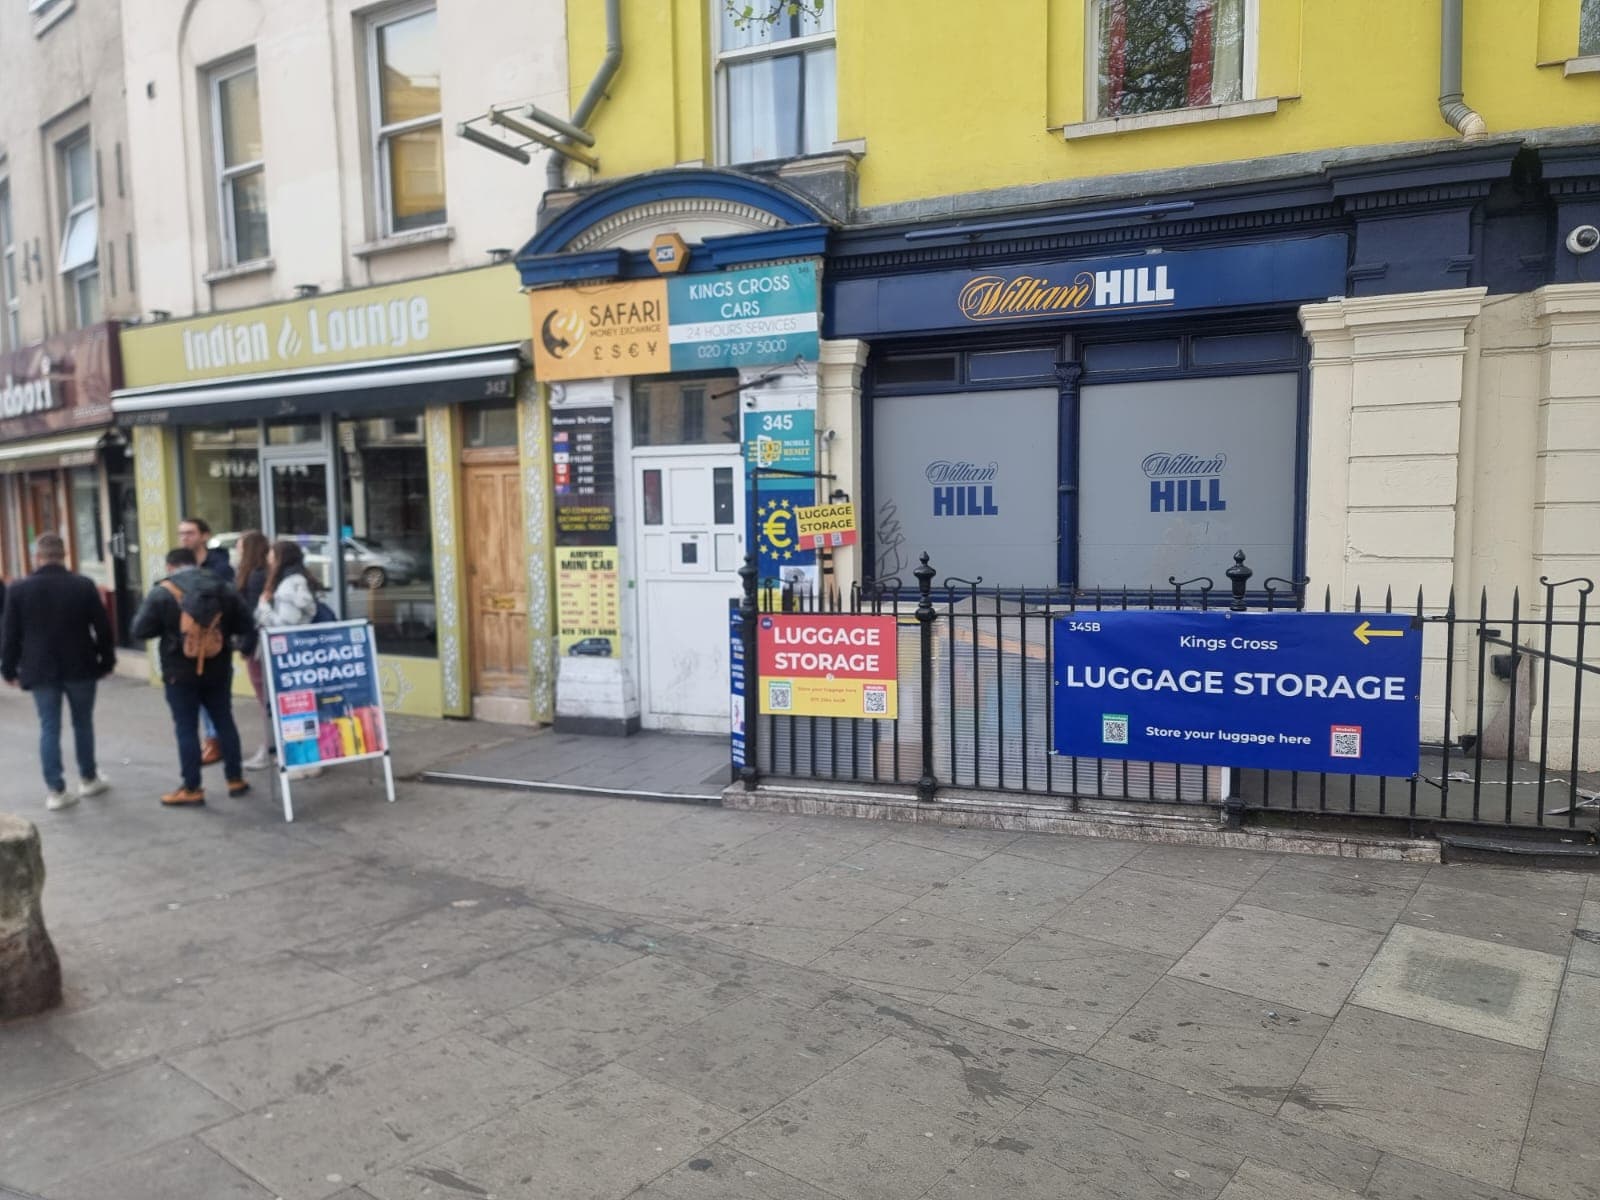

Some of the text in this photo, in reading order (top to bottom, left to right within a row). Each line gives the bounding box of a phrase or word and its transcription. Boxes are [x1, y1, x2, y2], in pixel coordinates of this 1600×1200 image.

[689, 275, 790, 300] KINGS CROSS
[959, 265, 1175, 319] William HILL
[590, 299, 661, 327] SAFARI
[721, 301, 760, 319] CARS
[183, 296, 429, 371] Indian Lounge
[688, 319, 797, 339] 24 HOURS SERVICES
[593, 341, 657, 360] £ $ € ¥
[697, 339, 787, 358] 020 7837 5000
[763, 414, 793, 431] 345
[925, 460, 998, 485] William
[1142, 452, 1227, 478] William
[933, 486, 998, 516] HILL
[1150, 479, 1226, 513] HILL
[799, 506, 853, 520] LUGGAGE
[800, 519, 853, 533] STORAGE
[561, 560, 613, 570] MINI CAB
[774, 626, 880, 646] LUGGAGE
[1069, 621, 1101, 632] 345B
[1180, 635, 1278, 651] Kings Cross
[277, 644, 365, 669] LUGGAGE
[774, 652, 880, 672] STORAGE
[280, 662, 367, 687] STORAGE
[1067, 665, 1406, 701] LUGGAGE STORAGE
[1145, 726, 1311, 746] Store your luggage here
